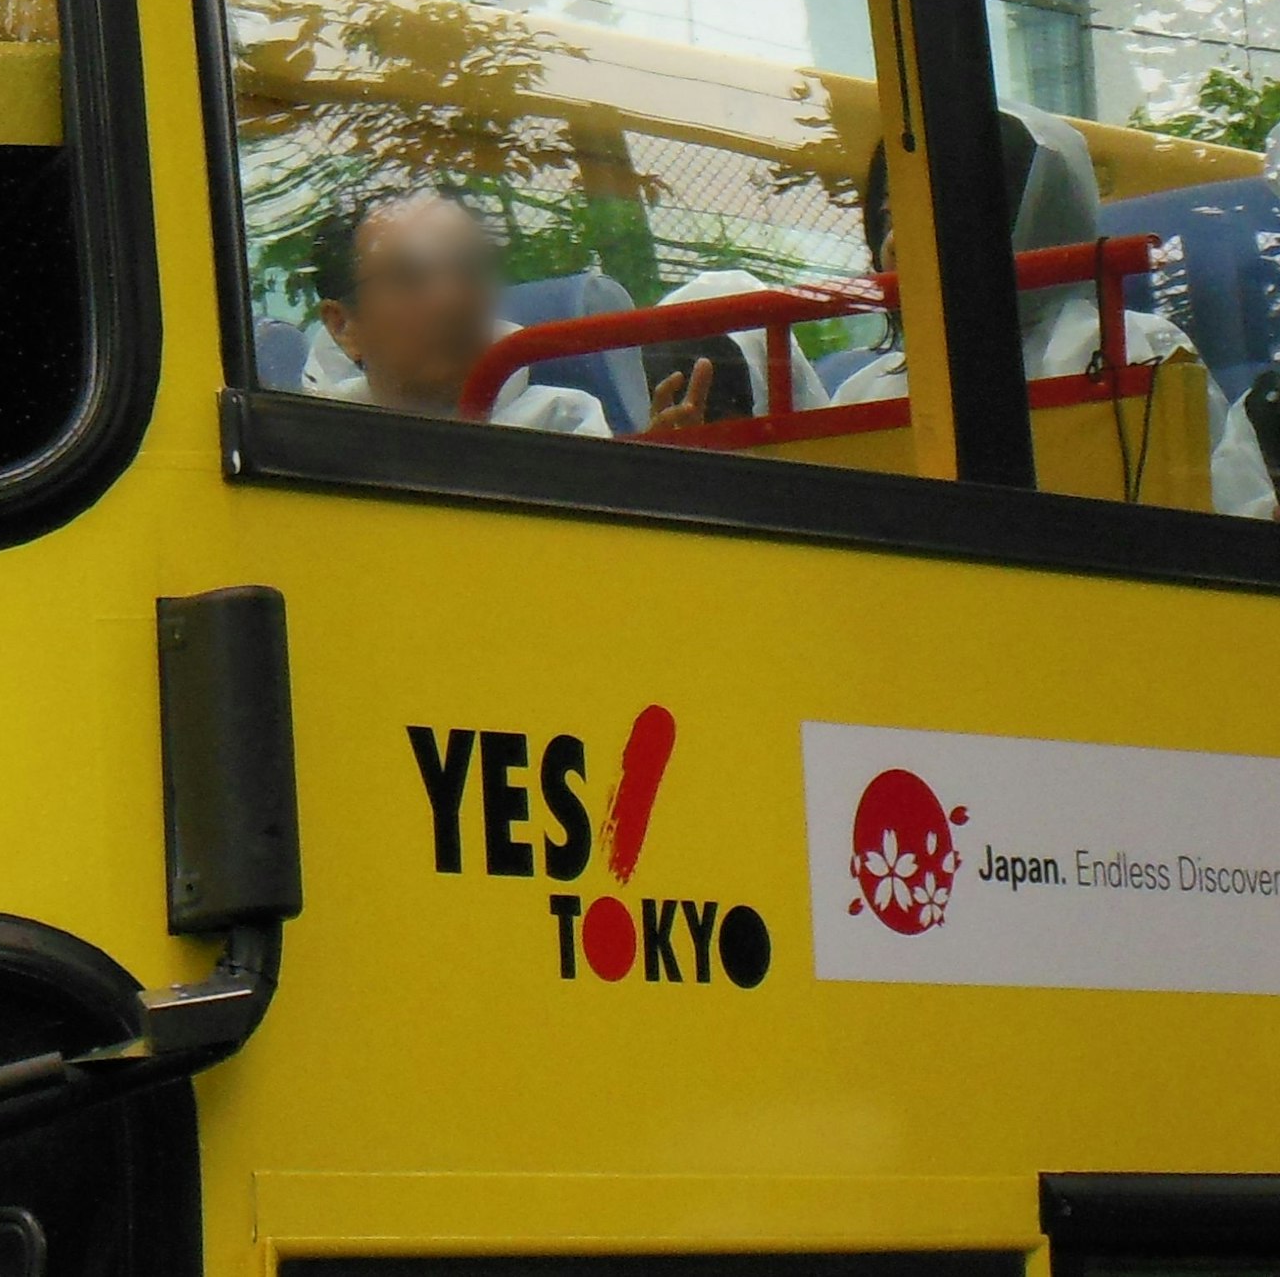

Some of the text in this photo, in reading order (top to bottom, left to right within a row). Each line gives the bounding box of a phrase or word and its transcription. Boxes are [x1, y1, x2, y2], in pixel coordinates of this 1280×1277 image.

[978, 844, 1067, 892] Japan.
[1075, 849, 1171, 891] Endless
[549, 894, 772, 990] TOKYO
